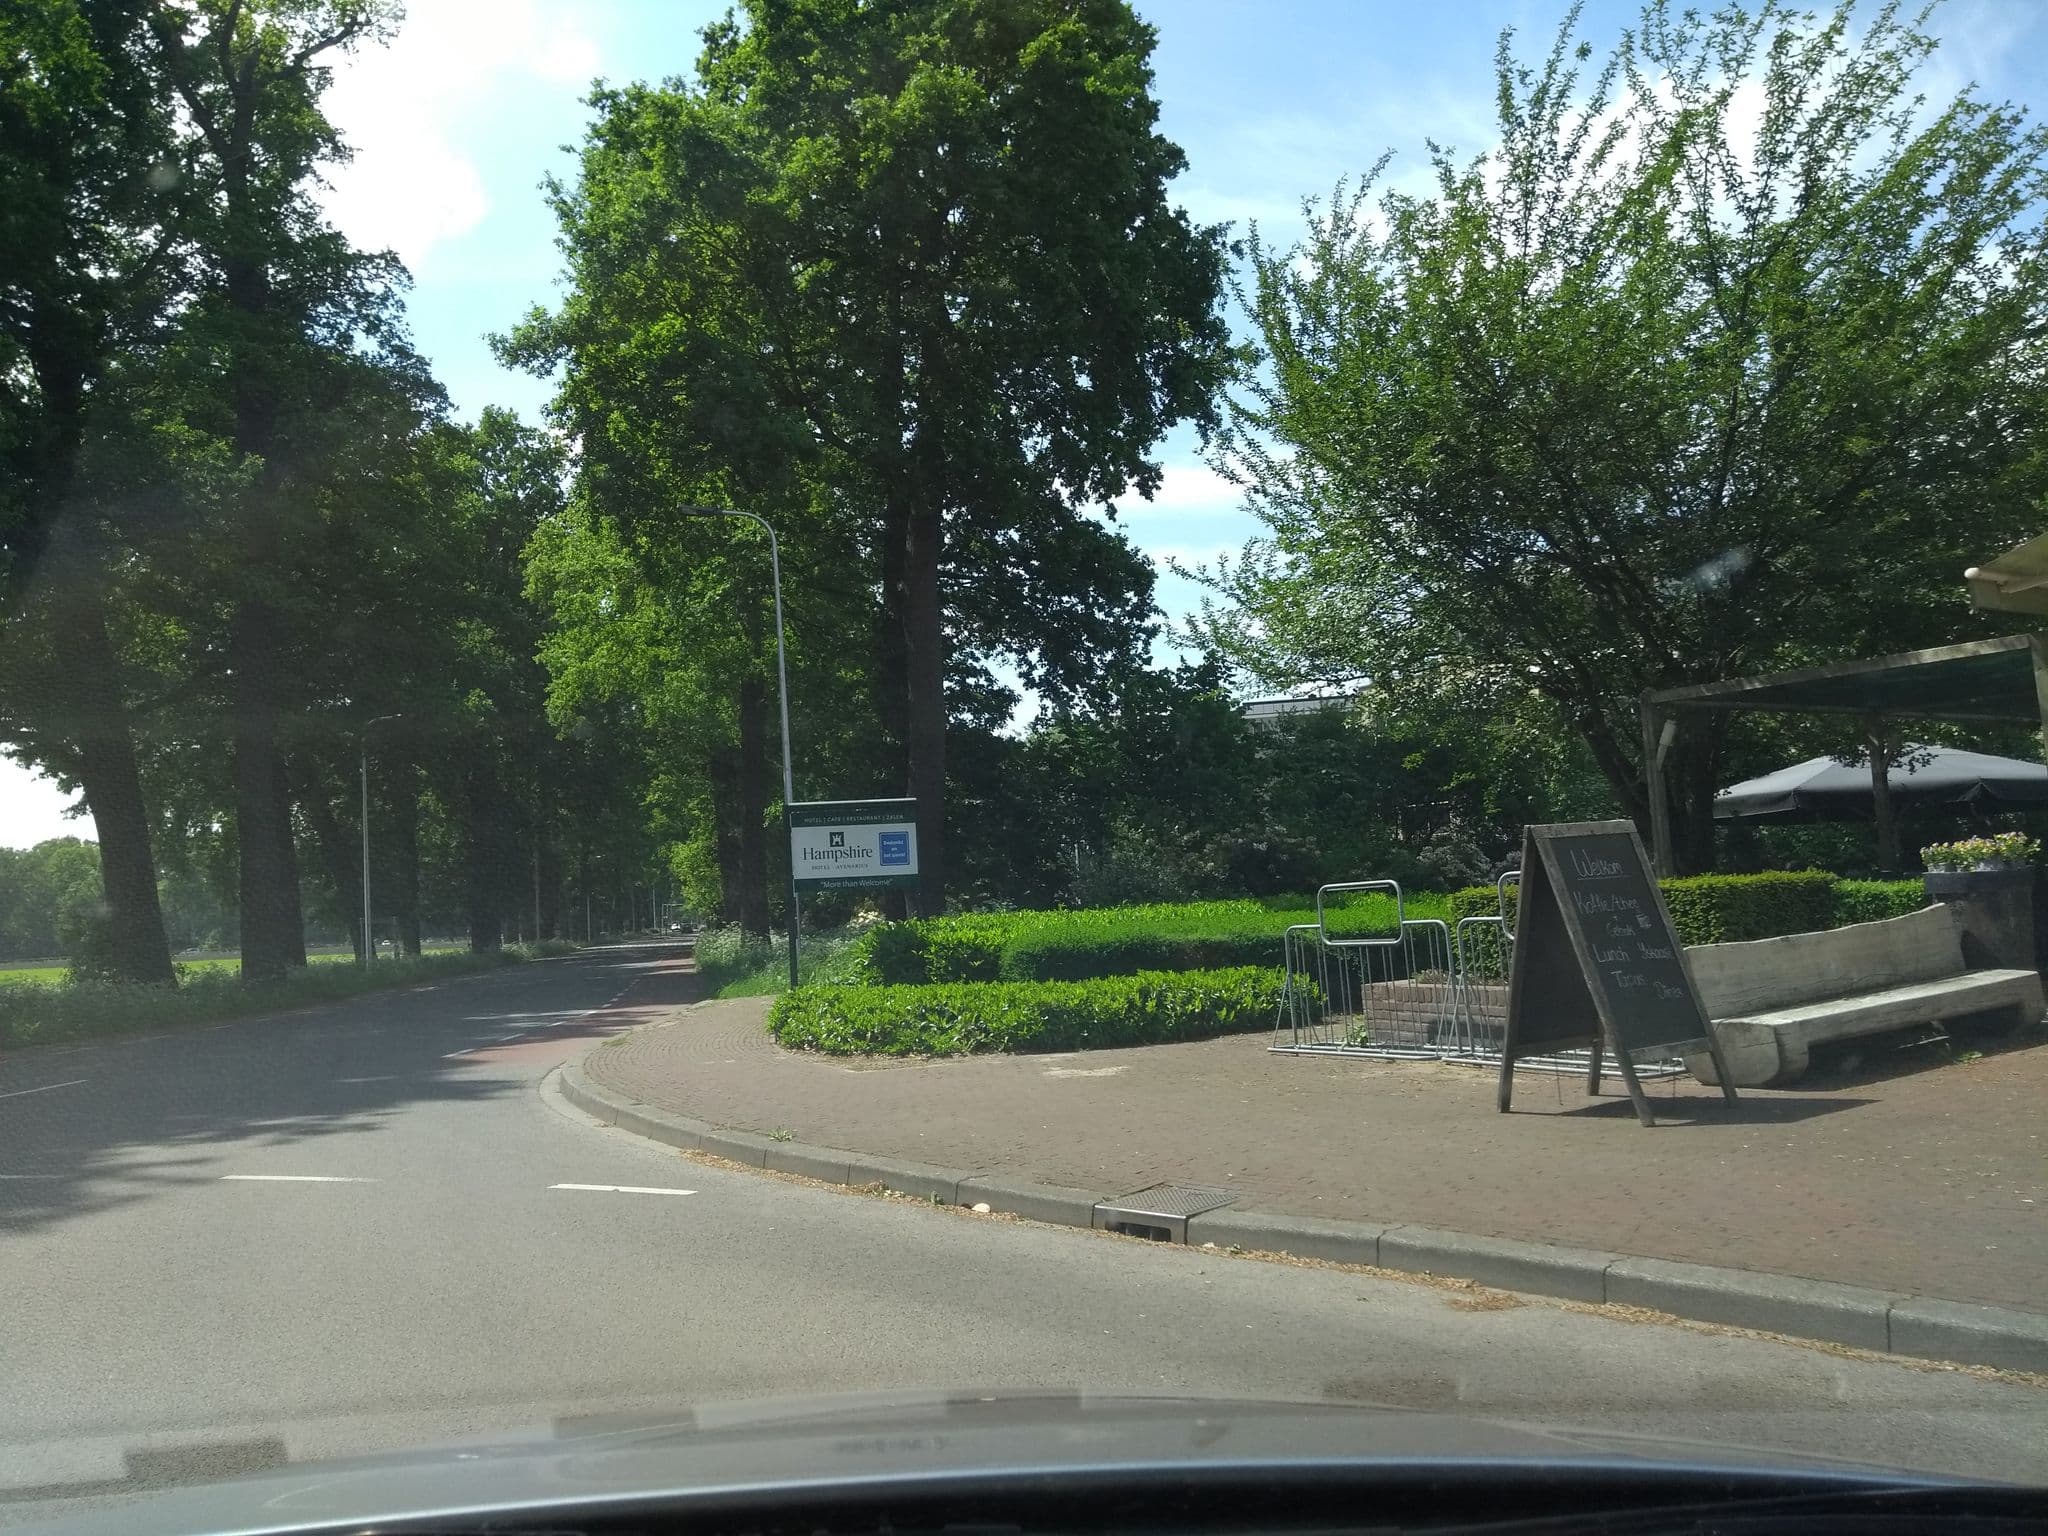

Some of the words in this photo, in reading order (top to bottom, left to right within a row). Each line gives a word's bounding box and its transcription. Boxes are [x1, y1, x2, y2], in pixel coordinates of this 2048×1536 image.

[803, 845, 873, 863] Hampshire
[1569, 849, 1624, 877] Welkom
[842, 878, 858, 887] than
[1592, 944, 1630, 963] Lunch
